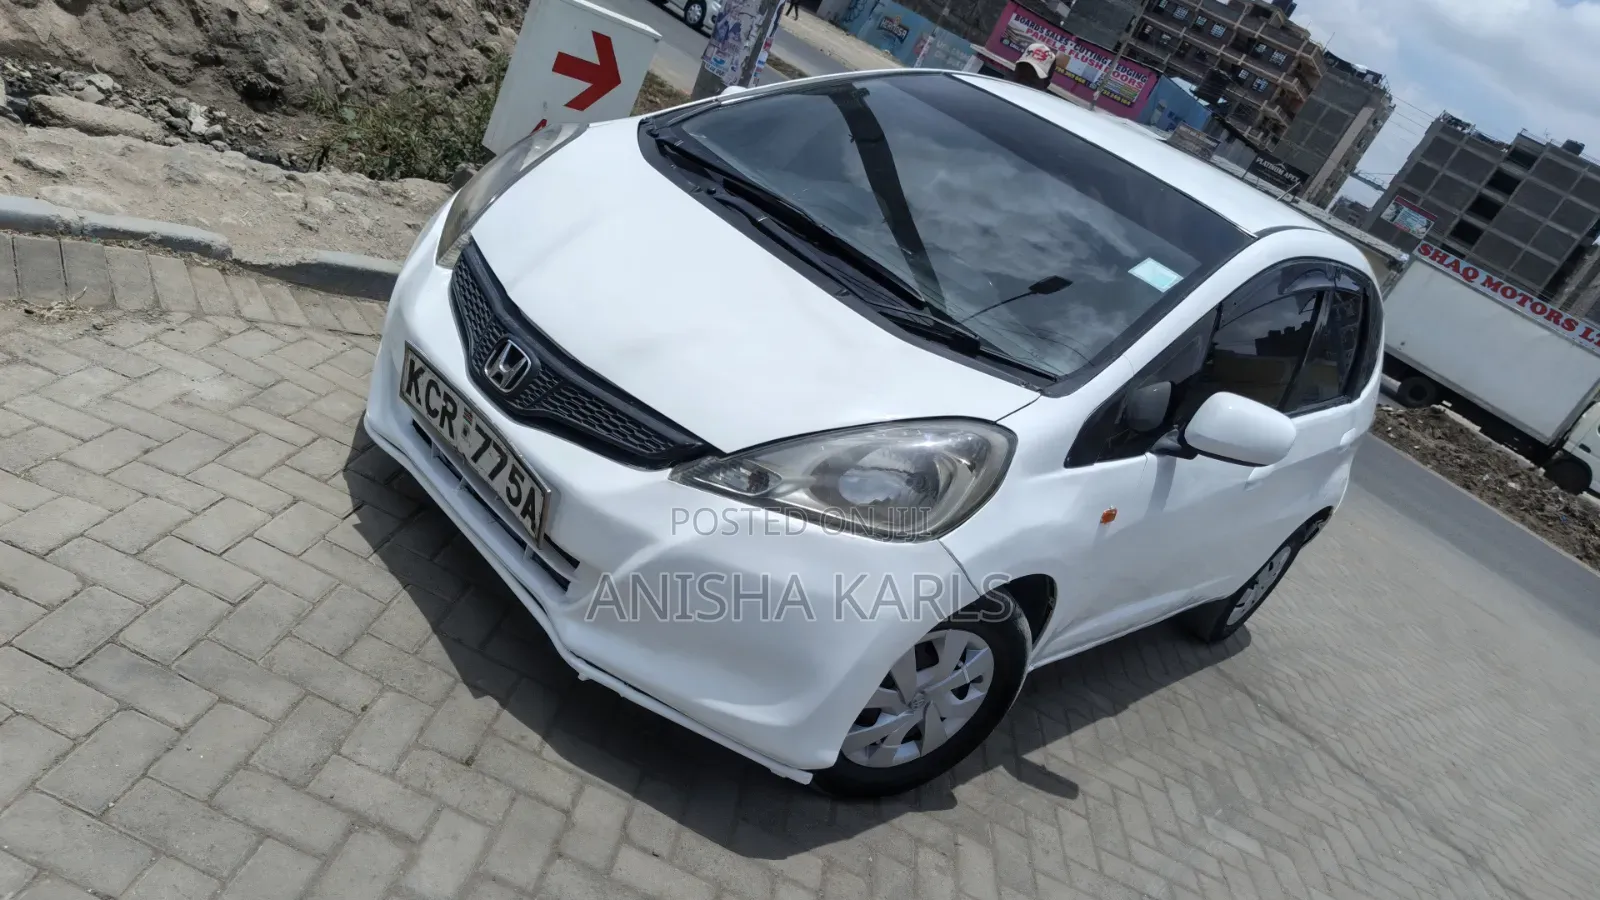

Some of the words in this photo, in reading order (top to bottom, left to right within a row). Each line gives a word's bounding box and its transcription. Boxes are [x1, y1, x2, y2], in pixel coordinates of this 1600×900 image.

[1014, 14, 1045, 33] BOARDS
[1044, 29, 1069, 46] SALES
[1073, 43, 1108, 65] CUTTING
[1115, 63, 1148, 83] EDGING
[1025, 27, 1058, 50] PANEL
[1068, 49, 1103, 71] FLUSH
[1256, 156, 1284, 176] PLATINUM
[1418, 243, 1479, 283] SHAQ
[1480, 274, 1579, 332] MOTORS
[404, 358, 458, 440] KCR
[470, 424, 537, 533] 775A
